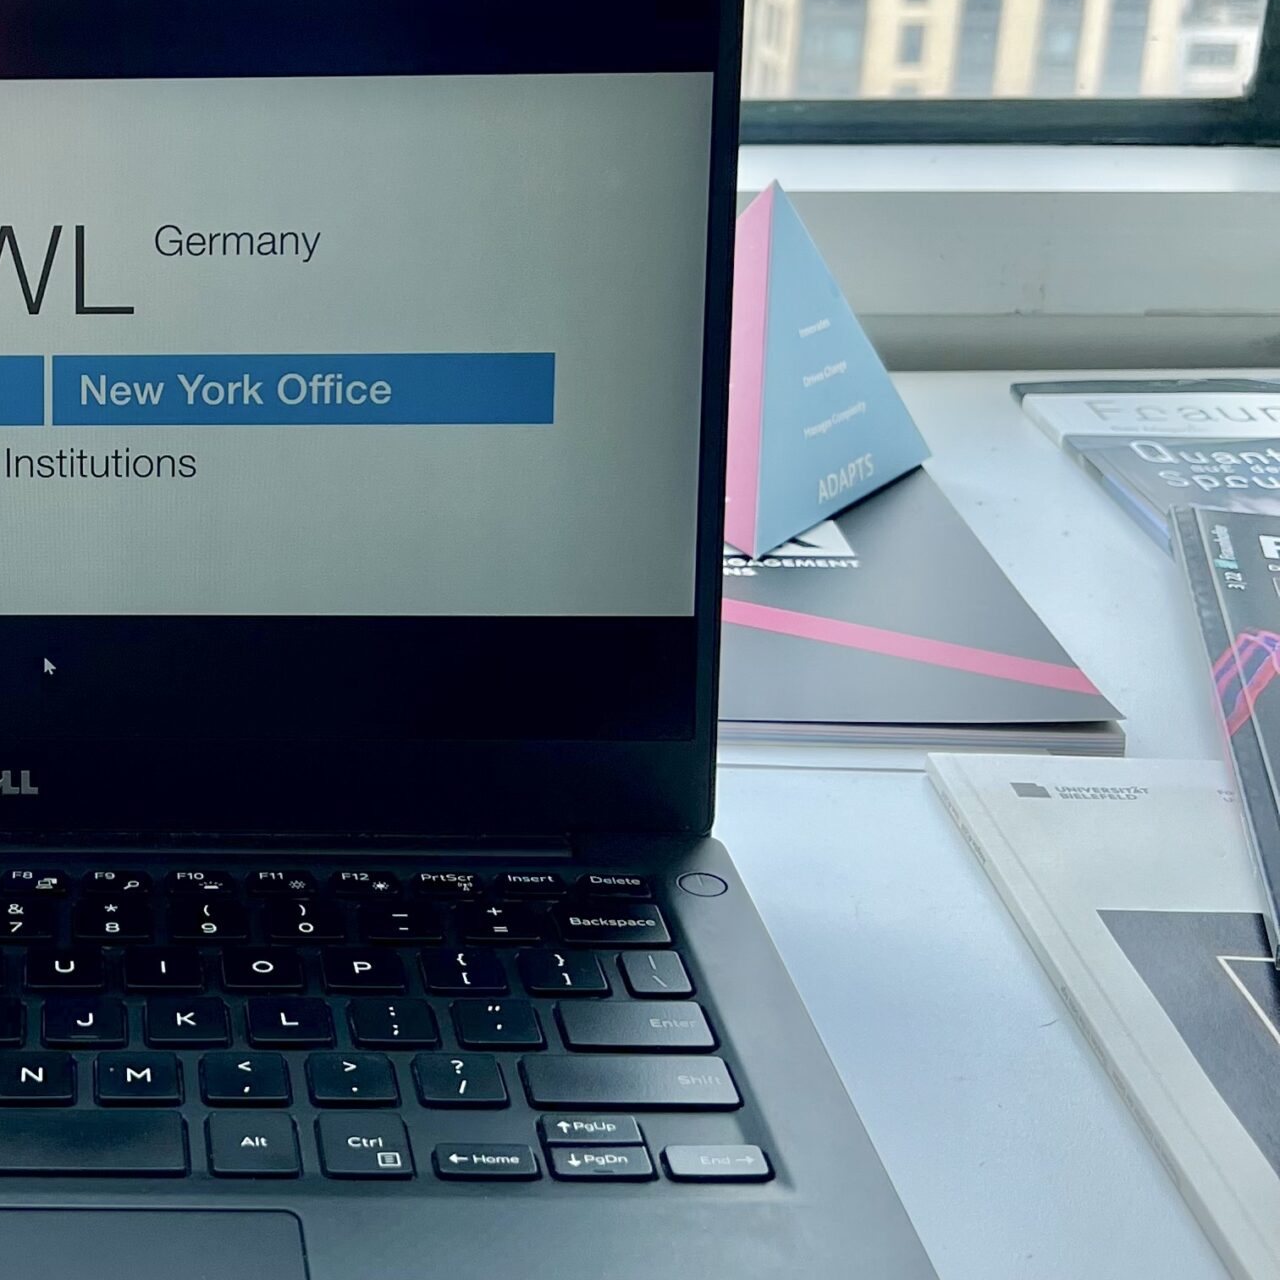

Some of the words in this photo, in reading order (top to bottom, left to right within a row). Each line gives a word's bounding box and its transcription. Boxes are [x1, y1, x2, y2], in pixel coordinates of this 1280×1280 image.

[154, 225, 320, 262] Germany
[80, 375, 164, 405] New
[177, 373, 263, 405] York
[277, 372, 392, 404] Office
[5, 448, 196, 478] Institutions
[818, 453, 874, 504] ADAPTS
[1059, 792, 1138, 800] BIELEFELD
[95, 872, 115, 880] F9
[177, 872, 204, 880] F10
[259, 872, 283, 880] F11
[342, 872, 369, 881] F12
[421, 874, 473, 882] PrtScr
[508, 874, 554, 883] Insert
[590, 876, 641, 886] Delete
[8, 904, 24, 914] &
[9, 922, 22, 932] 7
[105, 922, 119, 932] 8
[201, 923, 217, 933] 9
[299, 923, 313, 932] 0
[570, 917, 656, 928] Backspace
[55, 961, 75, 972] U
[161, 961, 166, 973] I
[252, 961, 273, 972] O
[353, 962, 372, 973] P
[77, 1013, 93, 1026] J
[177, 1013, 196, 1025] K
[281, 1013, 299, 1025] L
[649, 1019, 696, 1028] Enter
[451, 1060, 464, 1074] ?
[21, 1068, 43, 1082] N
[127, 1068, 151, 1082] M
[678, 1075, 721, 1086] Shift
[573, 1122, 616, 1133] PgUp
[241, 1137, 267, 1147] Alt
[348, 1137, 382, 1147] Ctrl
[473, 1154, 519, 1165] Home
[584, 1154, 628, 1165] PgDn
[700, 1155, 730, 1166] End
